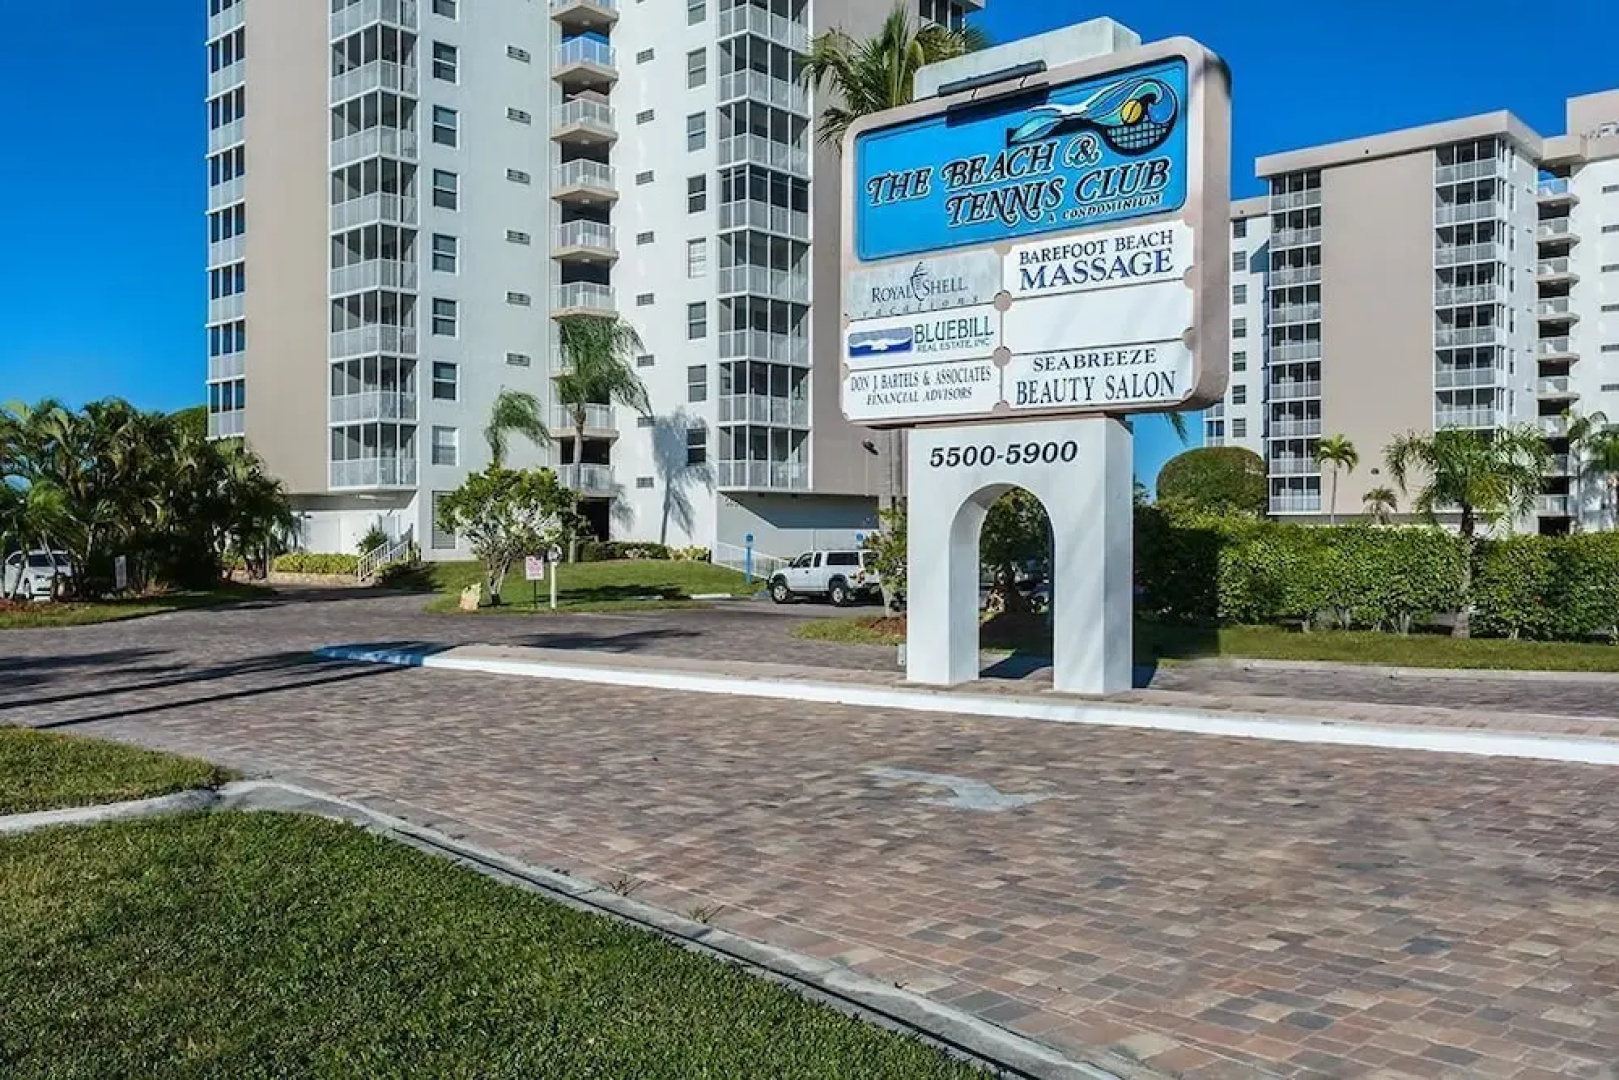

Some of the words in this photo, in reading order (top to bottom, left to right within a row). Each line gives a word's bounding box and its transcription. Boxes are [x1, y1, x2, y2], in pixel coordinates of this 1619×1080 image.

[866, 168, 932, 206] THE
[940, 141, 1059, 193] BEACH
[1063, 133, 1102, 169] &
[946, 177, 1066, 227] TENNIS
[1074, 157, 1172, 205] CLUB
[1063, 193, 1163, 219] CONDOMINIUM
[1019, 239, 1108, 265] BAREFOOT
[1114, 229, 1174, 251] BEACH
[1019, 248, 1174, 291] MASSAGE
[872, 286, 913, 303] ROYAL
[922, 276, 967, 297] SHELL
[914, 315, 995, 344] BLUEBILL
[917, 342, 938, 352] REAL
[1033, 347, 1157, 372] SEABREEZE
[851, 376, 869, 391] DON
[881, 371, 919, 389] BARTELS
[923, 370, 930, 386] &
[936, 365, 992, 385] ASSOCIATES
[1016, 376, 1096, 406] BEAUTY
[1105, 370, 1177, 400] SALON
[867, 390, 918, 406] FINANCIAL
[923, 386, 973, 402] ADVISORS
[930, 440, 1079, 468] 5500-5900
